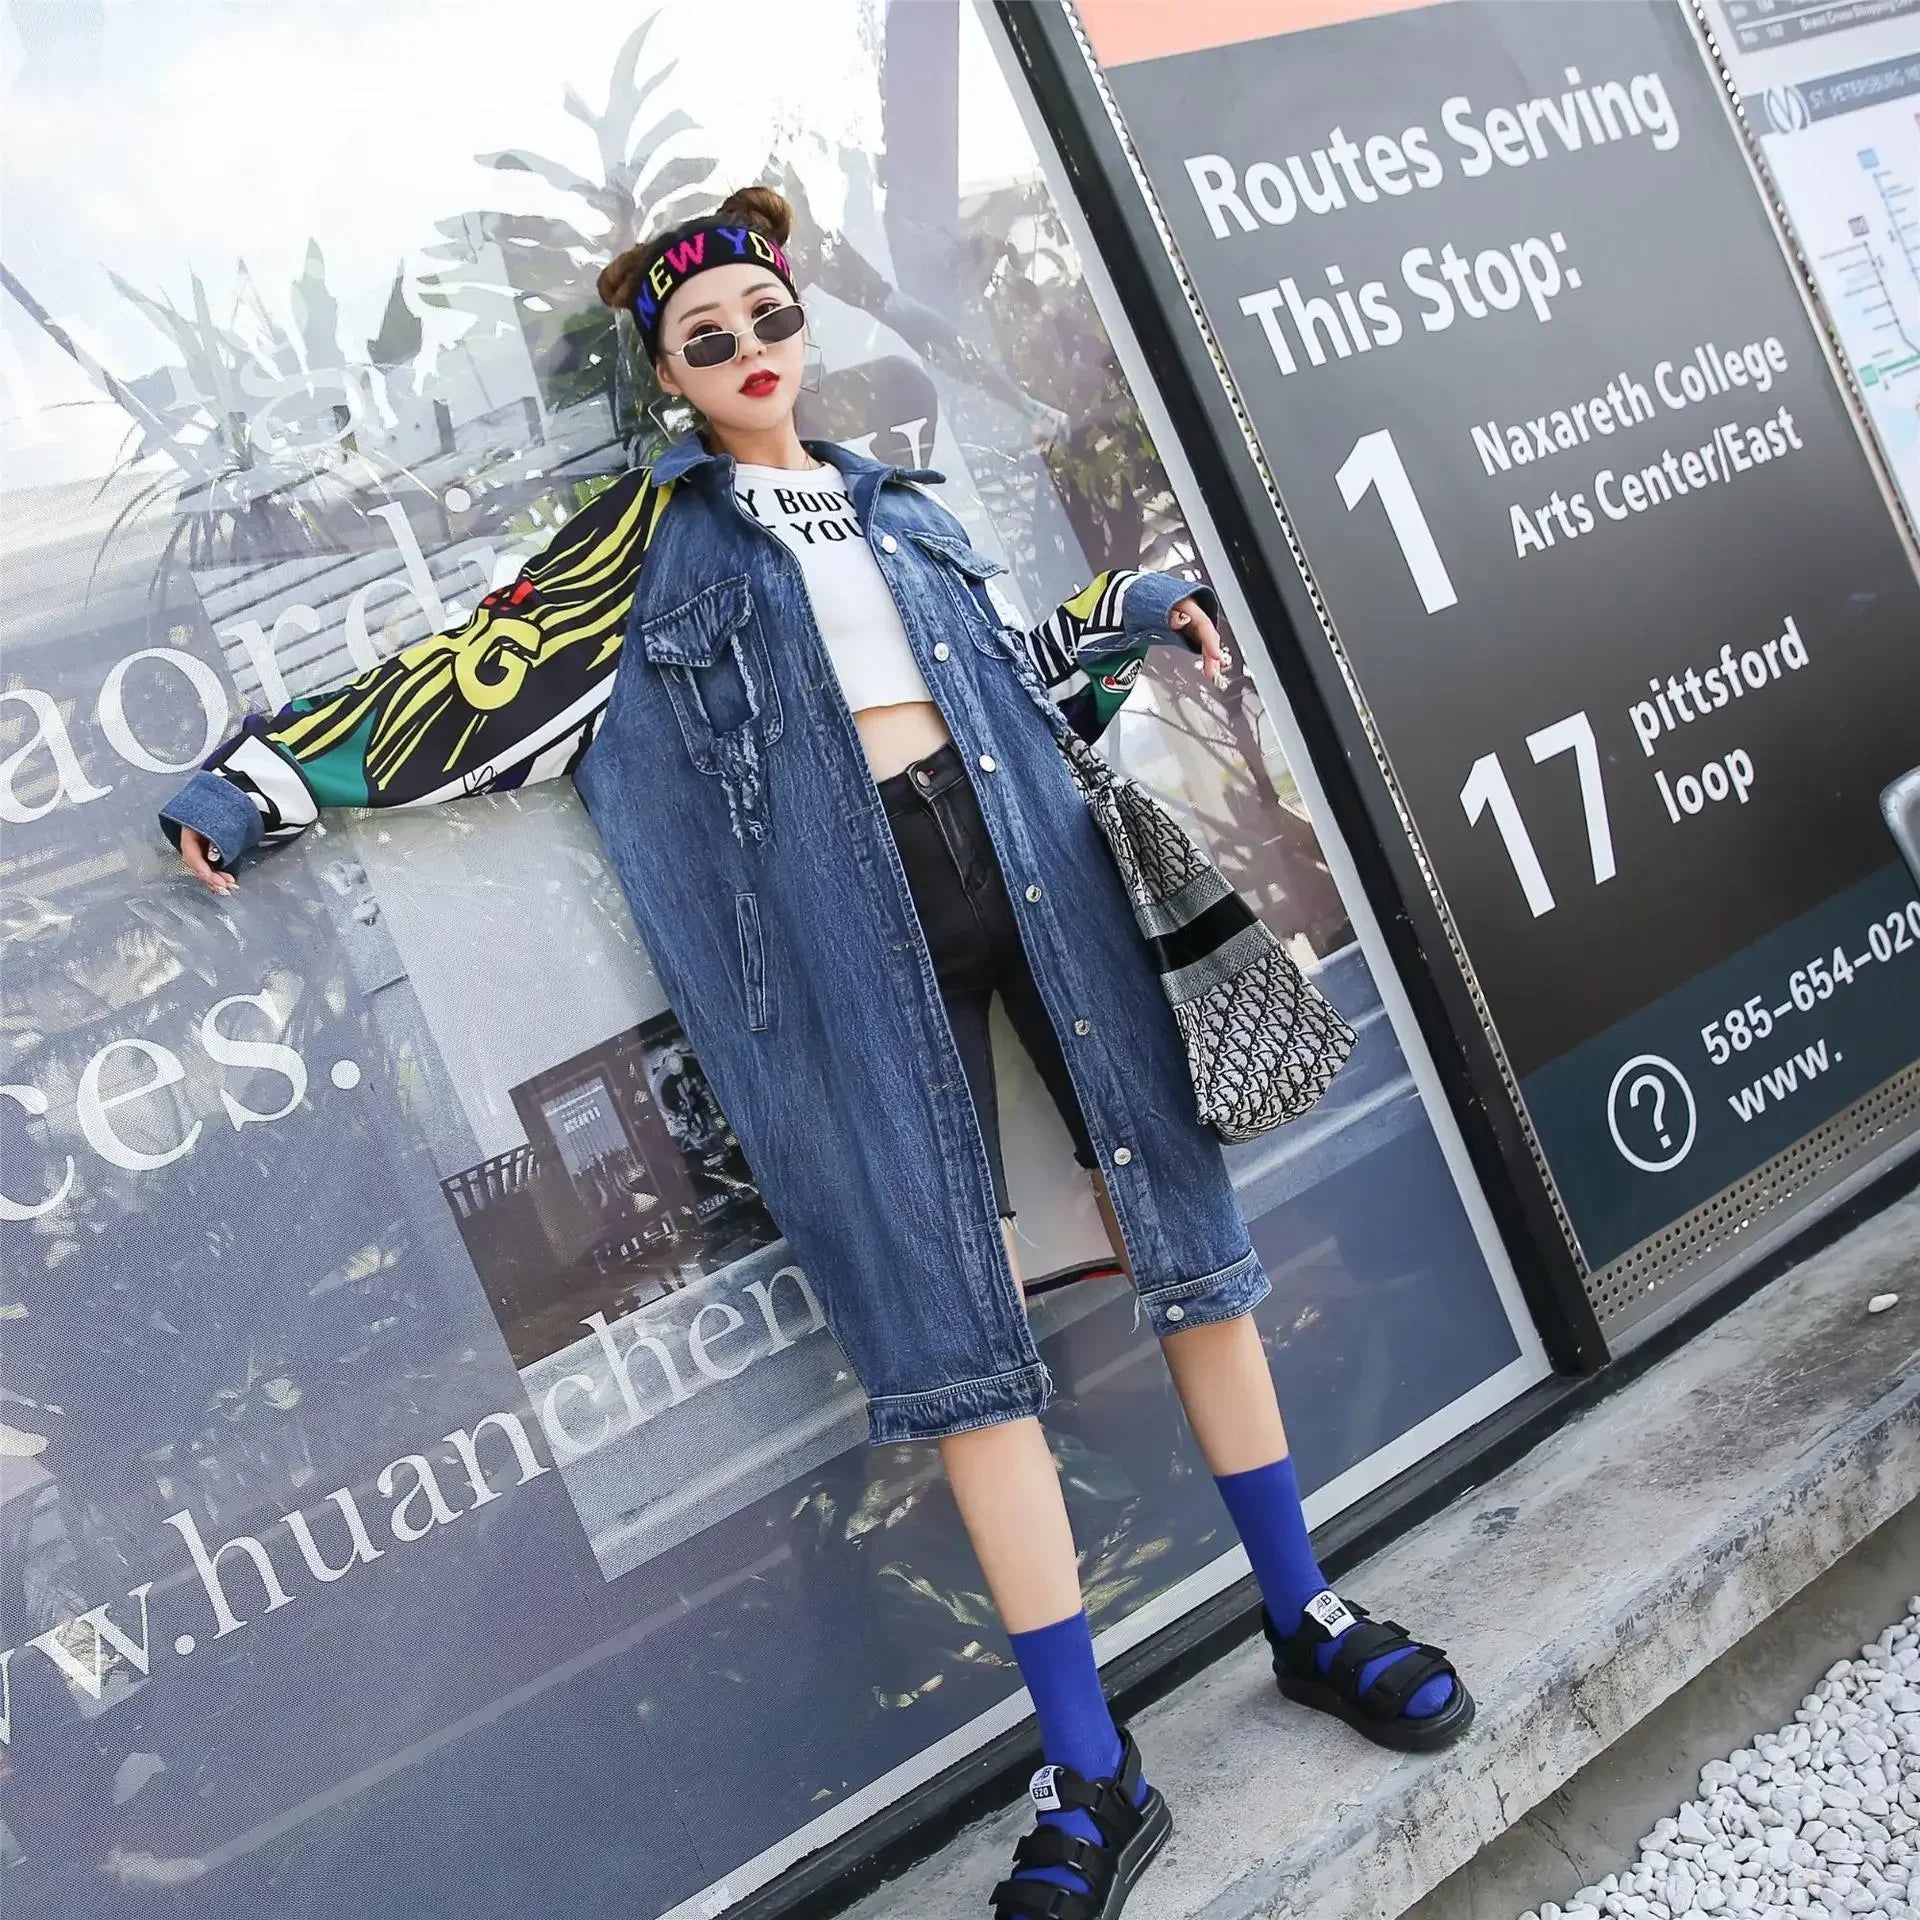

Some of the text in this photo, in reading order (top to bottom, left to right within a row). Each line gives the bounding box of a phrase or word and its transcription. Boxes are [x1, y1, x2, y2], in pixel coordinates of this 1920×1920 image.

[1184, 67, 1680, 240] Routes Serving
[636, 232, 705, 330] NEW
[1238, 231, 1582, 376] This Stop:
[1471, 335, 1788, 476] Naxareth College
[773, 488, 856, 514] BODY
[1334, 428, 1459, 615] 1
[1508, 406, 1803, 558] Arts Center/East
[1628, 616, 1810, 757] pittsford
[1460, 711, 1616, 919] 17
[1654, 748, 1755, 824] loop
[1728, 1038, 1843, 1122] www.
[0, 1265, 827, 1745] w.huanchen
